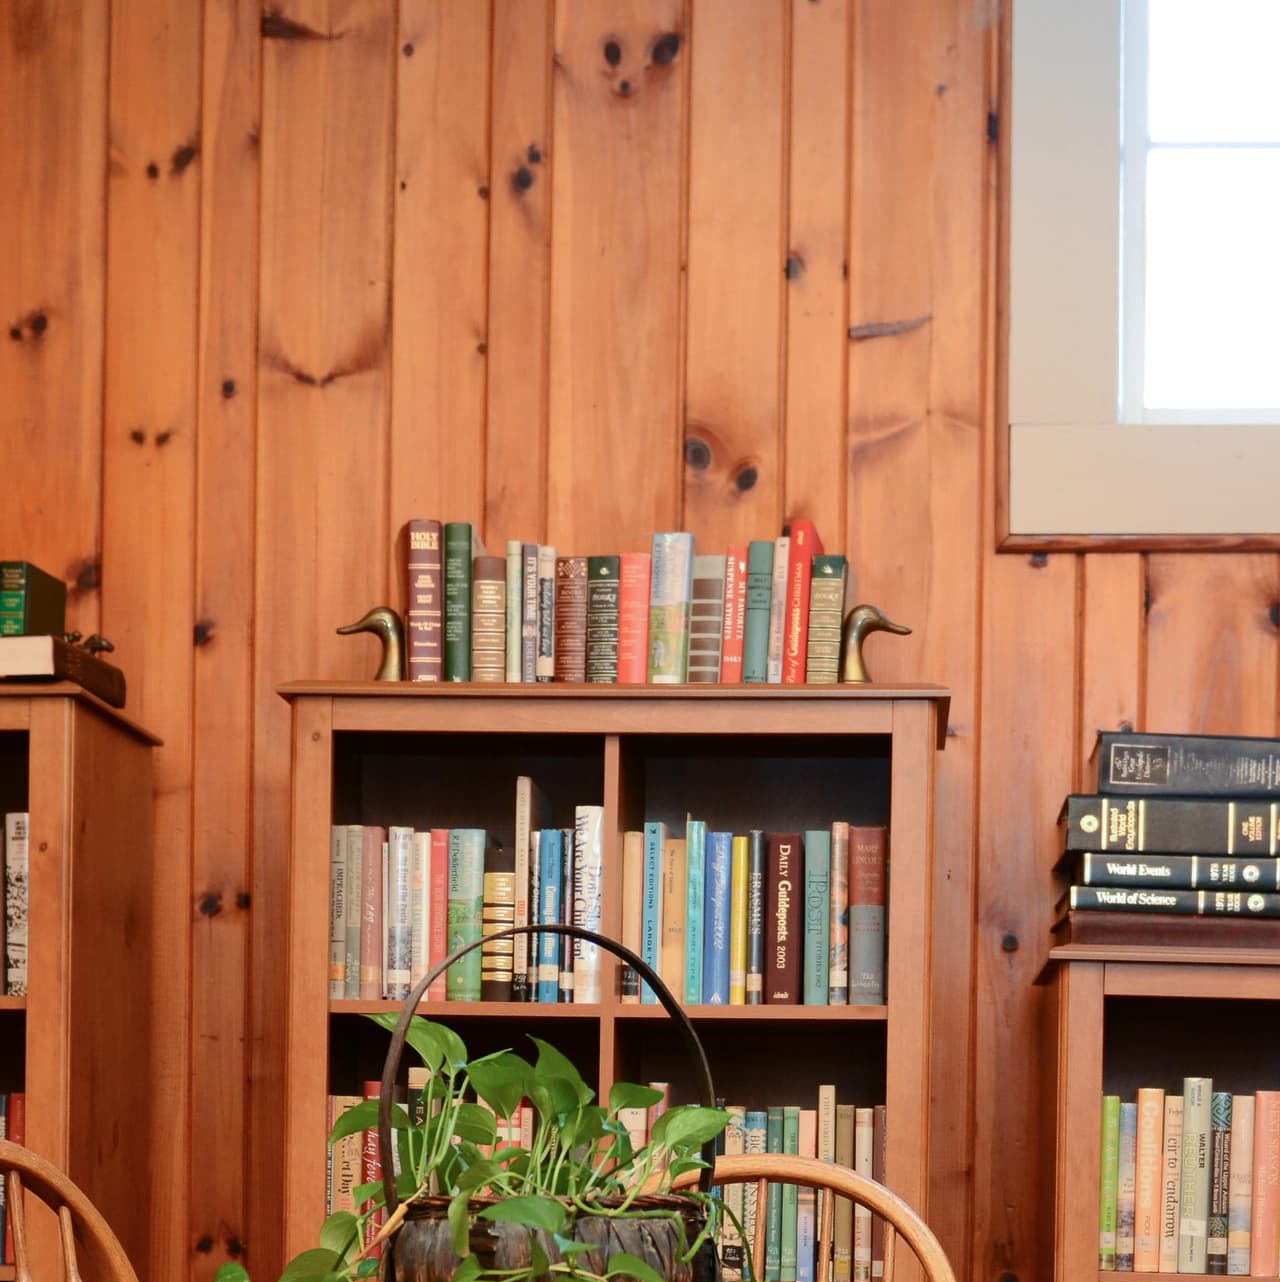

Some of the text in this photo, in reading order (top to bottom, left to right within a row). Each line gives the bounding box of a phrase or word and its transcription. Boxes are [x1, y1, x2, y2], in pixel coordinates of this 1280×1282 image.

[410, 532, 440, 542] HOLY
[411, 541, 440, 551] BIBLE
[527, 556, 537, 621] IT'S YOUR TIME
[724, 556, 735, 641] SUSPENSE STORIES
[1110, 807, 1119, 843] Illustrated
[1119, 813, 1127, 836] World
[1241, 821, 1249, 836] ONE
[1248, 816, 1256, 842] VOLUME
[575, 838, 588, 861] Are
[647, 842, 655, 871] SELECT
[779, 844, 791, 878] DAILY
[574, 863, 588, 897] Your
[1106, 862, 1171, 877] World Events
[336, 867, 345, 919] IMPEACHED:
[647, 873, 655, 909] EDITIONS
[751, 872, 762, 936] ERASMUS
[1096, 891, 1177, 907] World of Science
[574, 898, 587, 961] Chilen!
[647, 919, 655, 952] LARGE
[776, 946, 786, 969] 2003
[1167, 1157, 1179, 1169] to
[1198, 1133, 1207, 1169] WALTER
[1183, 1132, 1196, 1217] REUTHER
